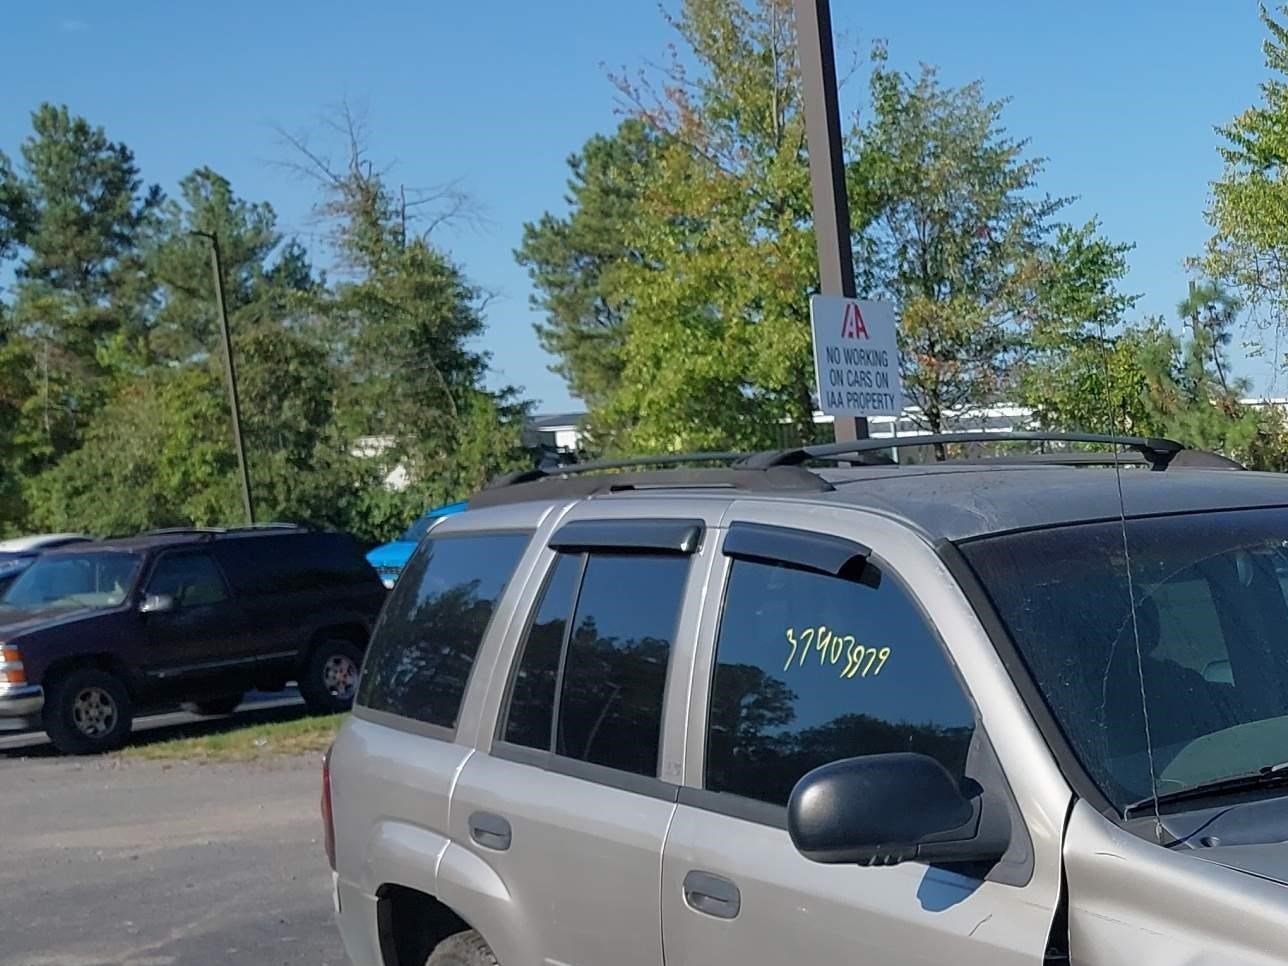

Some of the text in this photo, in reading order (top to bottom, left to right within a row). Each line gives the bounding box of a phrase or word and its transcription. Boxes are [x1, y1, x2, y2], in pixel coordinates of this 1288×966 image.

[826, 347, 889, 368] NO WORKING
[829, 369, 889, 389] ON CARS ON
[826, 391, 896, 411] IAA PROPERTY
